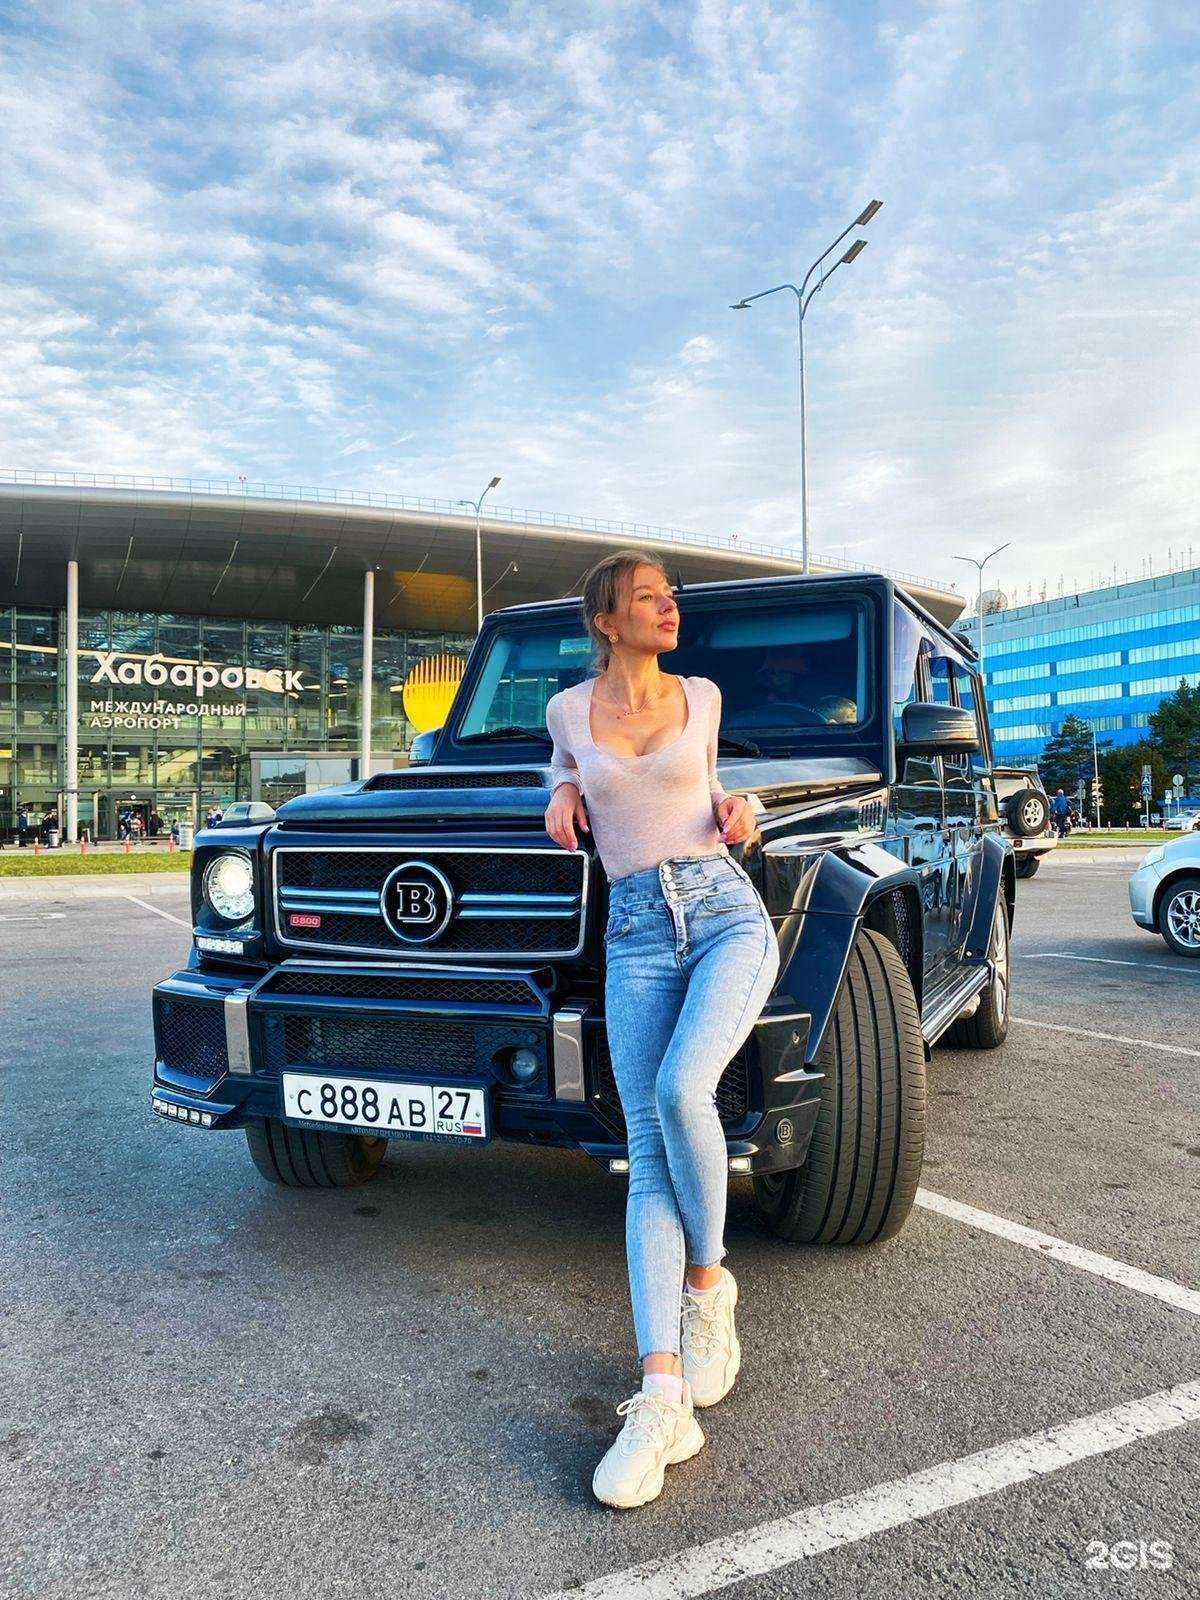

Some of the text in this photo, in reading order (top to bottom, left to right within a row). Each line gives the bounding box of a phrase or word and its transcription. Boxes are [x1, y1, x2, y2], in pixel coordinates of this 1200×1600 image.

[91, 652, 304, 698] Хабаровск
[91, 700, 247, 717] МЕЖДУНАРОДНЫЙ
[91, 716, 183, 730] АЭРОПОРТ
[397, 882, 436, 922] B
[438, 1090, 471, 1121] 27
[437, 1120, 462, 1133] RUS
